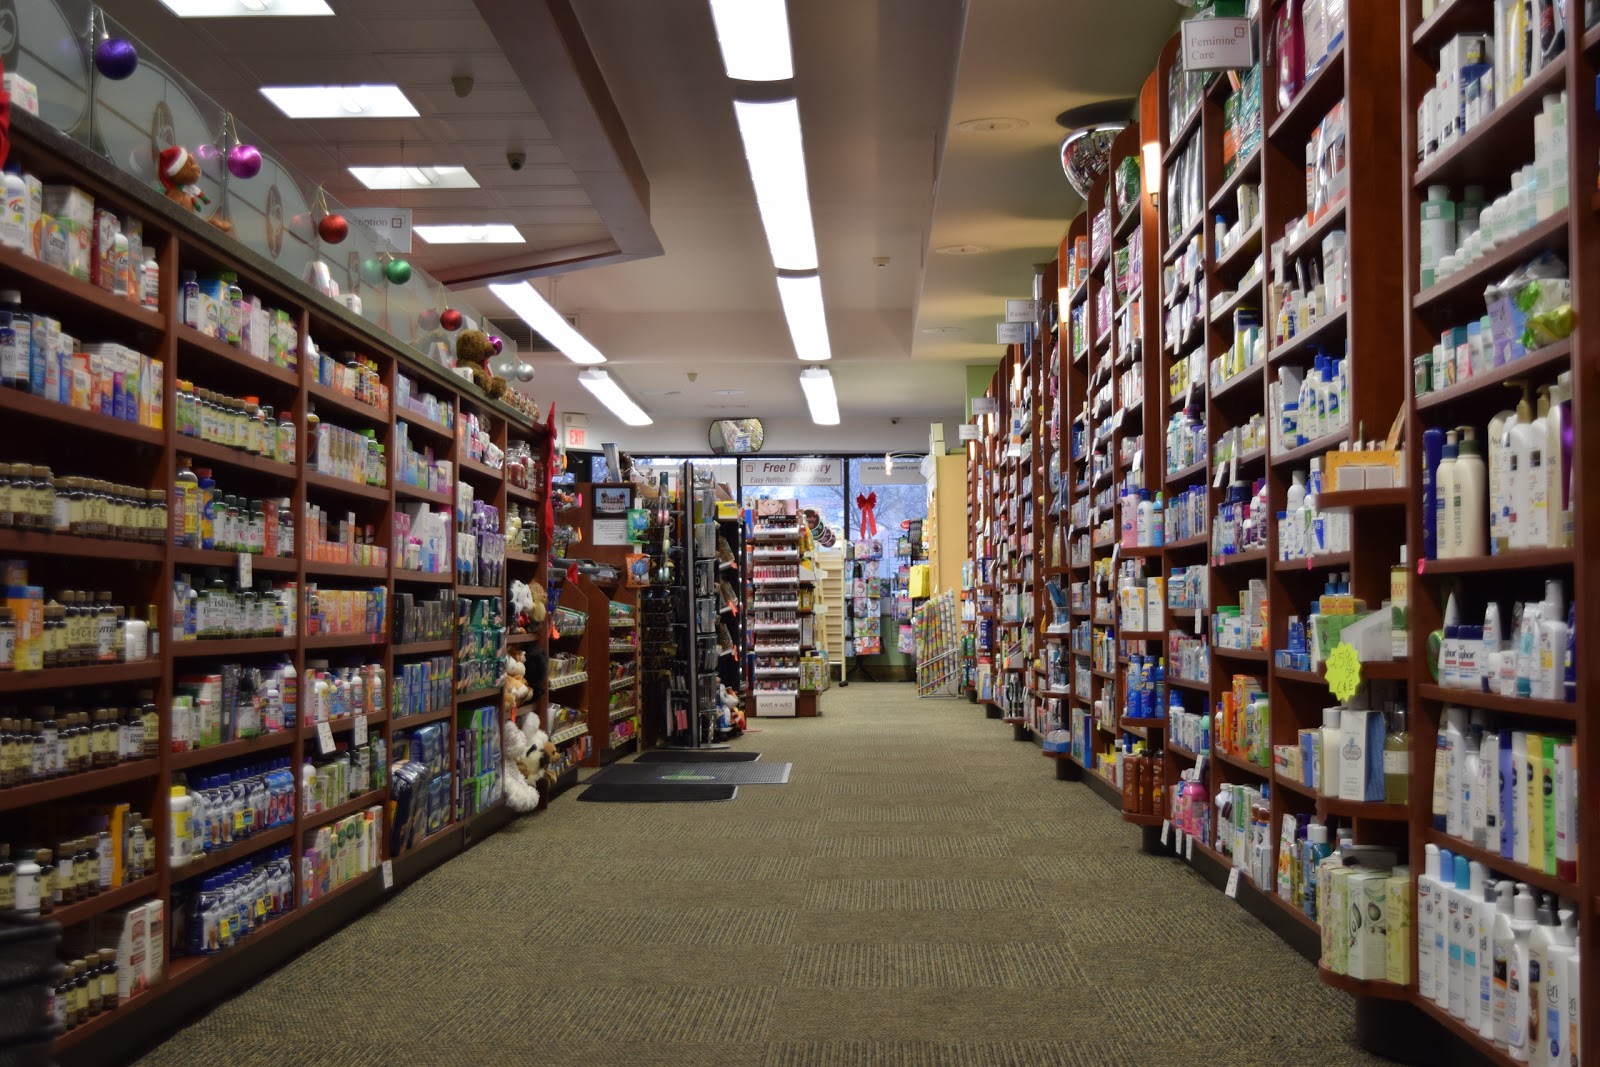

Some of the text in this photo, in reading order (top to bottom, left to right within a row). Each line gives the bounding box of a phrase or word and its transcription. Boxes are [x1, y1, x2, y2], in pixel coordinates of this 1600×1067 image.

[1191, 35, 1236, 47] Feminine
[1191, 51, 1215, 60] Care
[569, 429, 585, 446] EXIT
[763, 462, 832, 474] Free Delivery
[1329, 649, 1354, 670] 25%
